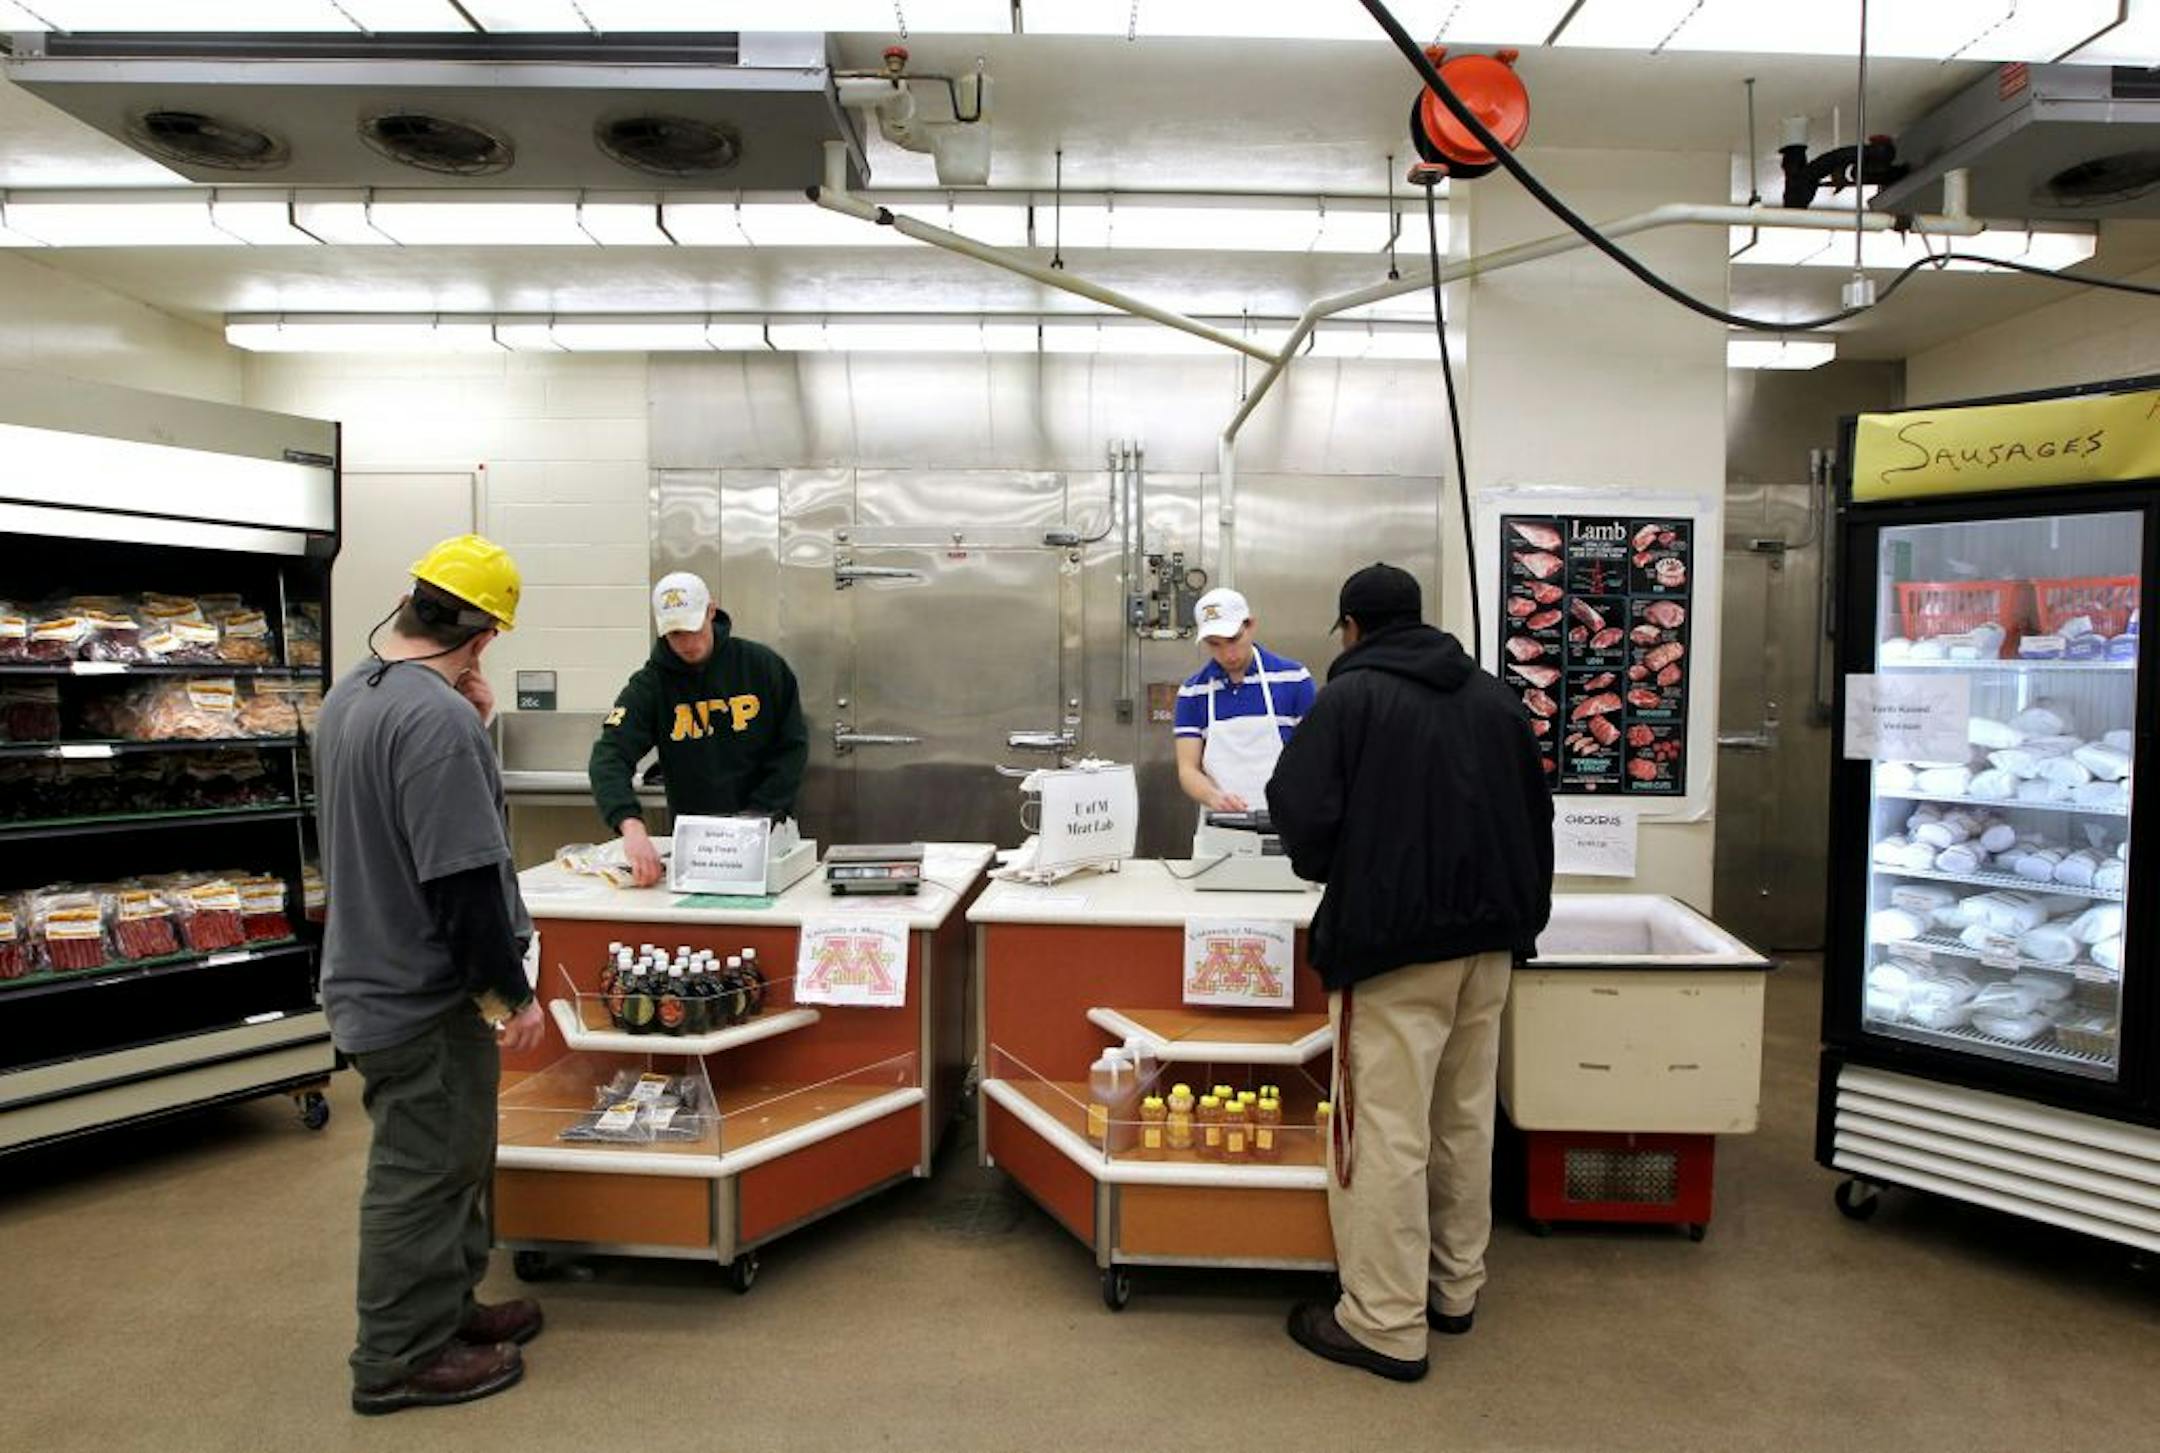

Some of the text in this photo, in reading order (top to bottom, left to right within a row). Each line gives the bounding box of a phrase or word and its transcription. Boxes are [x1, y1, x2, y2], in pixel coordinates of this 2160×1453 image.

[1572, 519, 1627, 541] Lamb
[1085, 801, 1097, 815] of
[1098, 799, 1109, 813] M
[1067, 819, 1115, 835] Meat Lab
